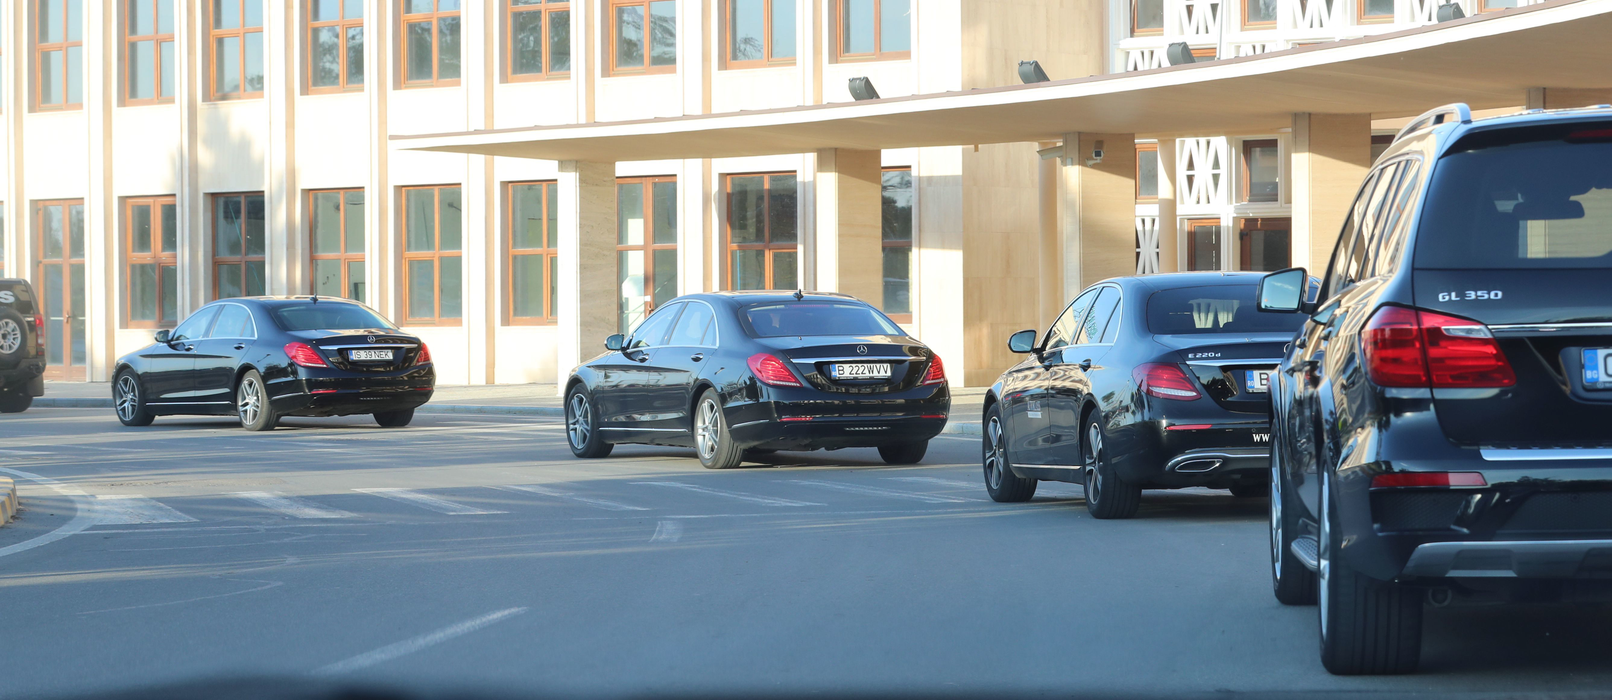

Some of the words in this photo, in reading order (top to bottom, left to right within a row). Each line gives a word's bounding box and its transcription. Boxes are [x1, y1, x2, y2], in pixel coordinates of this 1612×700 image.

[1464, 290, 1503, 300] 350
[374, 350, 390, 359] NEK
[837, 365, 845, 376] B
[1586, 370, 1598, 379] BG
